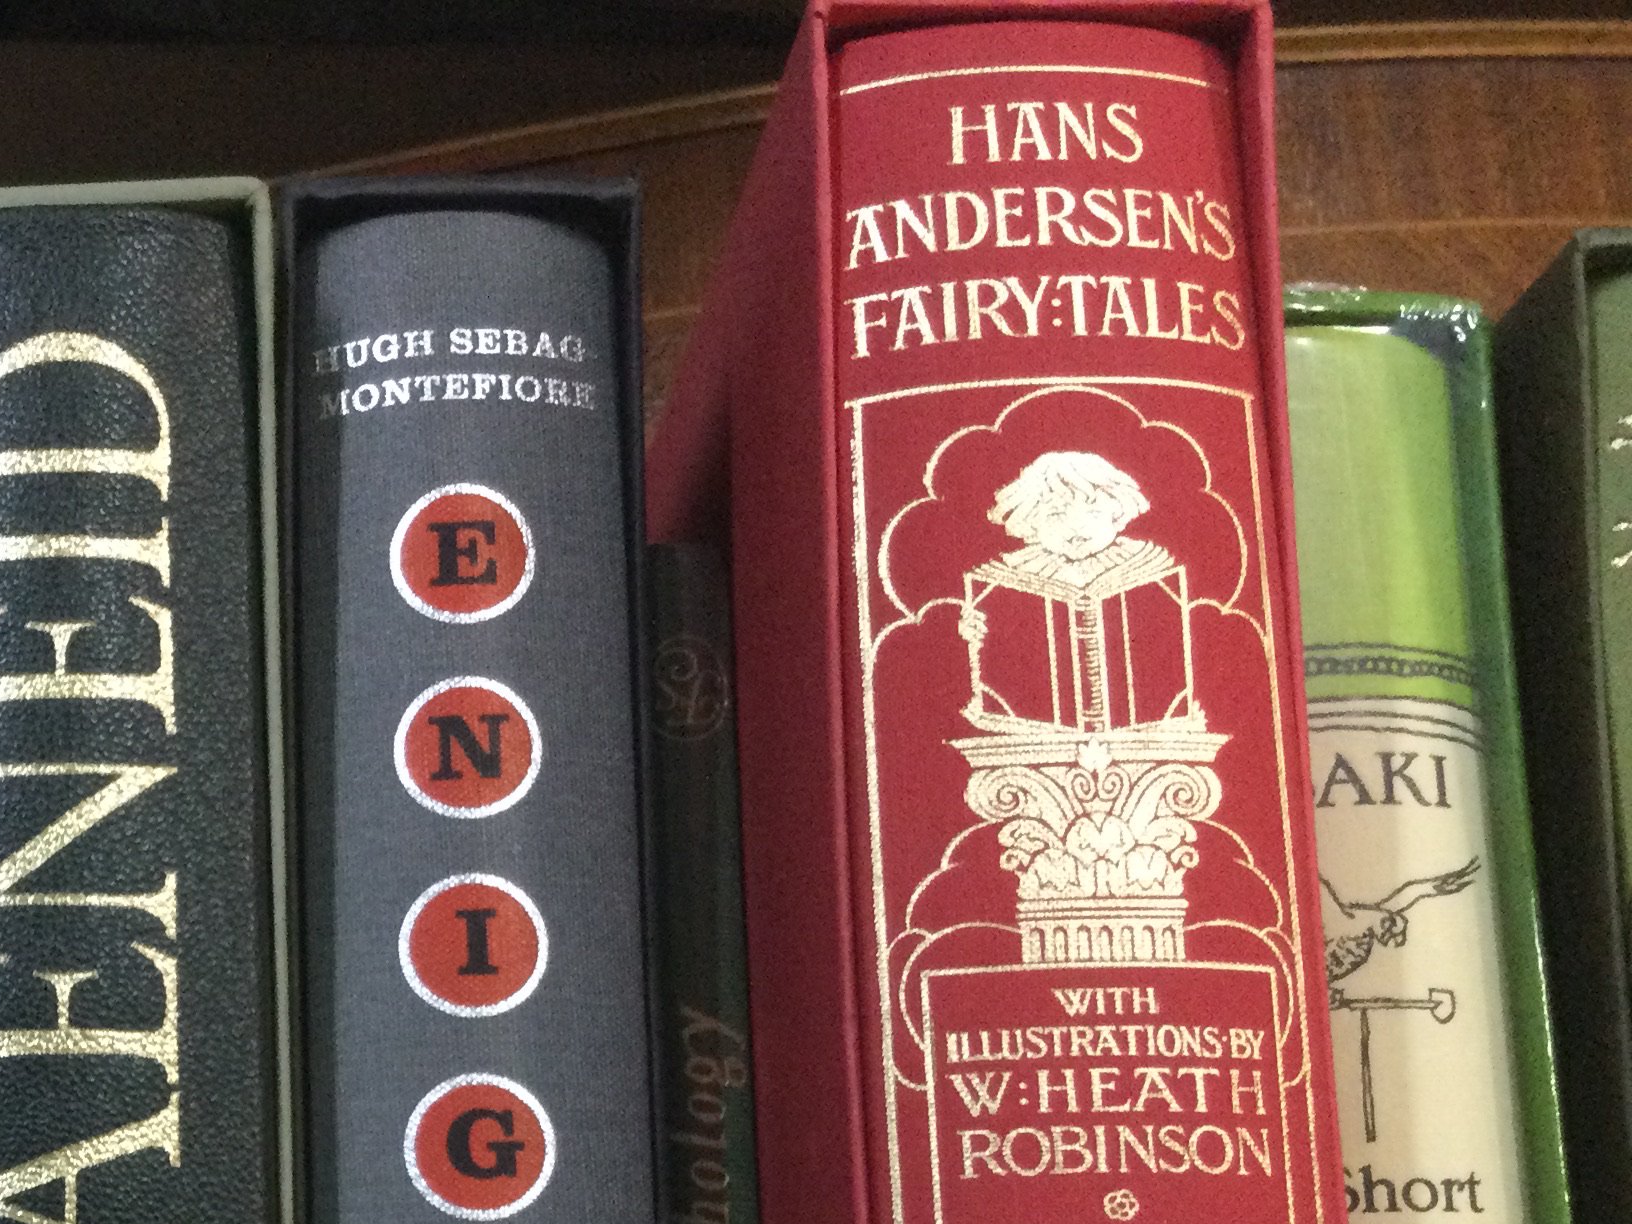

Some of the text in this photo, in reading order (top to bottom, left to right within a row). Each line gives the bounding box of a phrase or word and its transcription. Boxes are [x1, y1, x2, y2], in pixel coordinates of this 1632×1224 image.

[948, 101, 1144, 165] HANS
[843, 186, 1236, 271] ANDERSEN'S
[314, 328, 586, 374] HUGH SEBAG
[1313, 751, 1452, 809] AKI
[1051, 987, 1160, 1018] WITH
[957, 1124, 1272, 1180] ROBINSON
